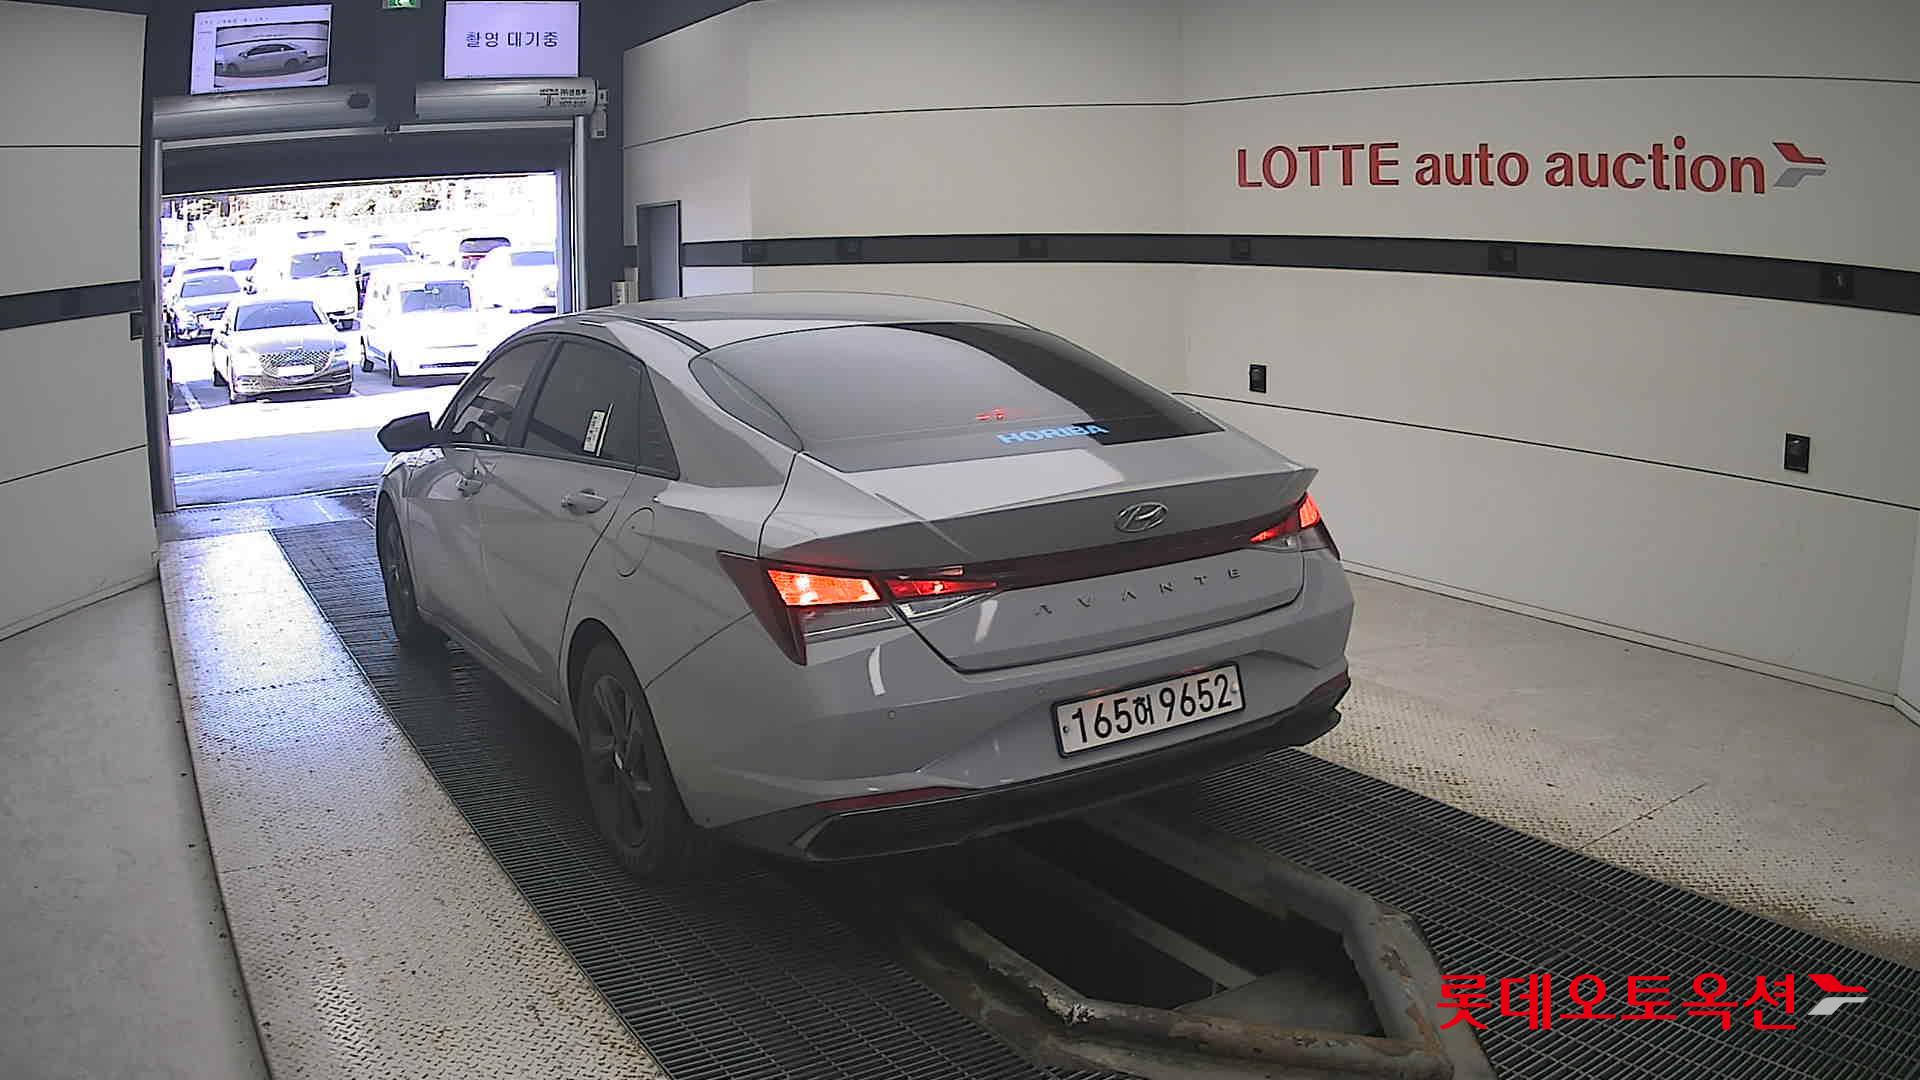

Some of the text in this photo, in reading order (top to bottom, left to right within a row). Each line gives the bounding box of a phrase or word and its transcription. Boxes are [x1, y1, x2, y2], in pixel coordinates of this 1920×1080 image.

[507, 31, 559, 48] 대기중
[1237, 135, 1767, 195] LOTTE auto auction
[997, 424, 1109, 444] HORIBA
[1034, 568, 1241, 617] AVANTE
[1159, 674, 1233, 722] 9652
